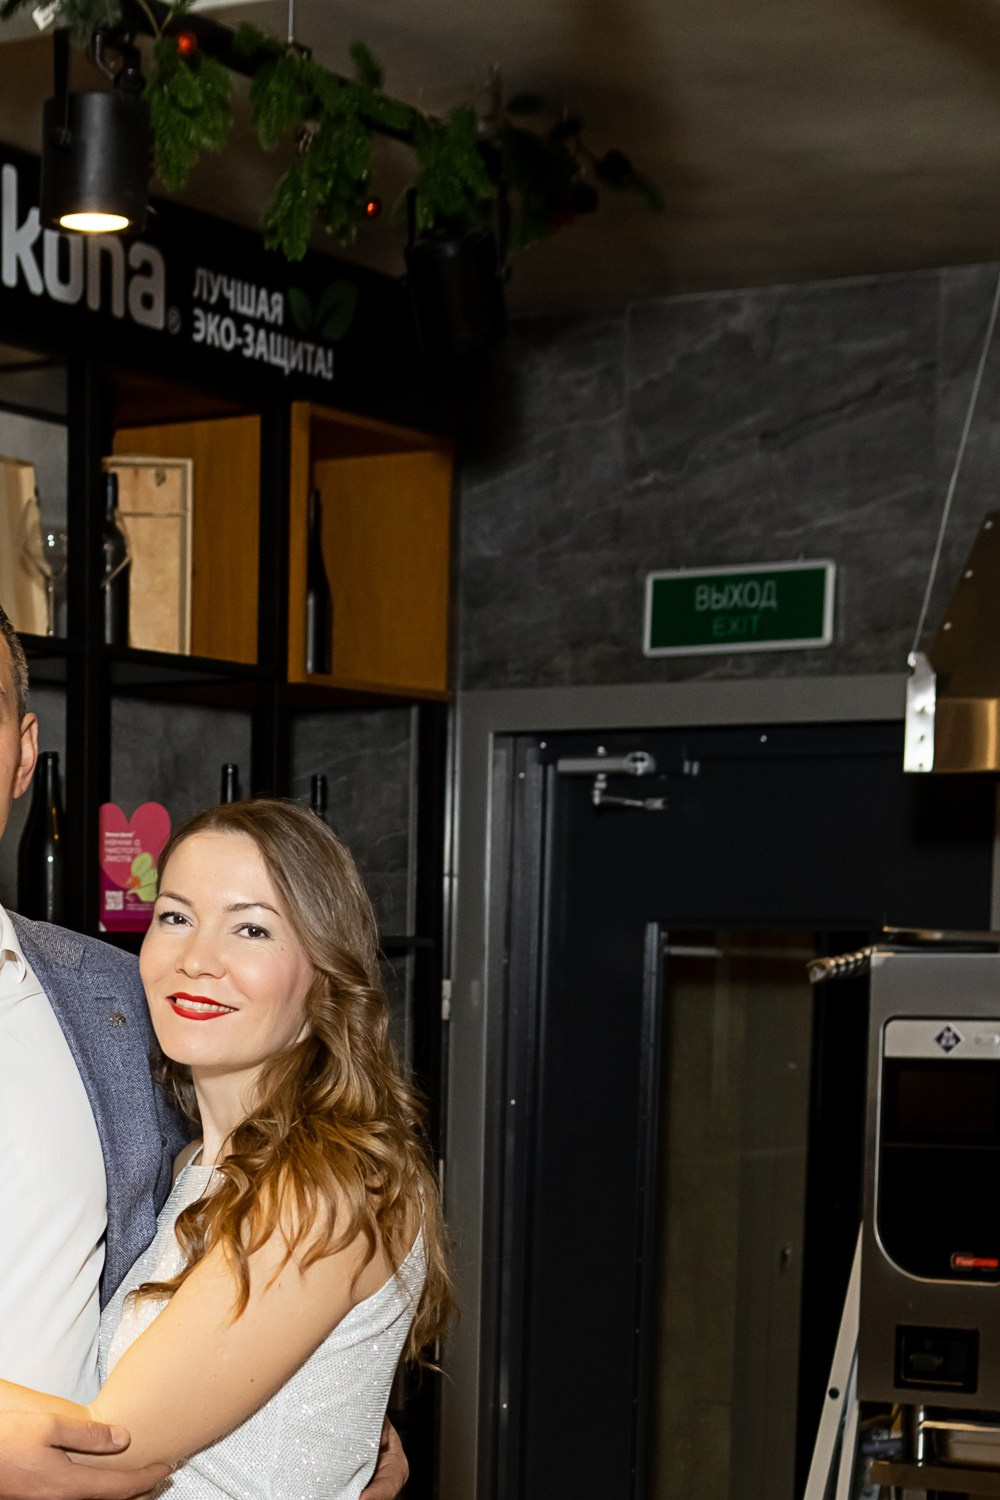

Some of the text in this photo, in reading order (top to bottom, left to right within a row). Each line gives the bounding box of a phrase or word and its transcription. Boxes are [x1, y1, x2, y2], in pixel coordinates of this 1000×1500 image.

[193, 268, 285, 325] ЛУЧШАЯ
[192, 308, 334, 380] ЭКО-ЗАЩИТА!
[695, 580, 778, 612] ВЫХОД
[712, 614, 762, 637] EXIT
